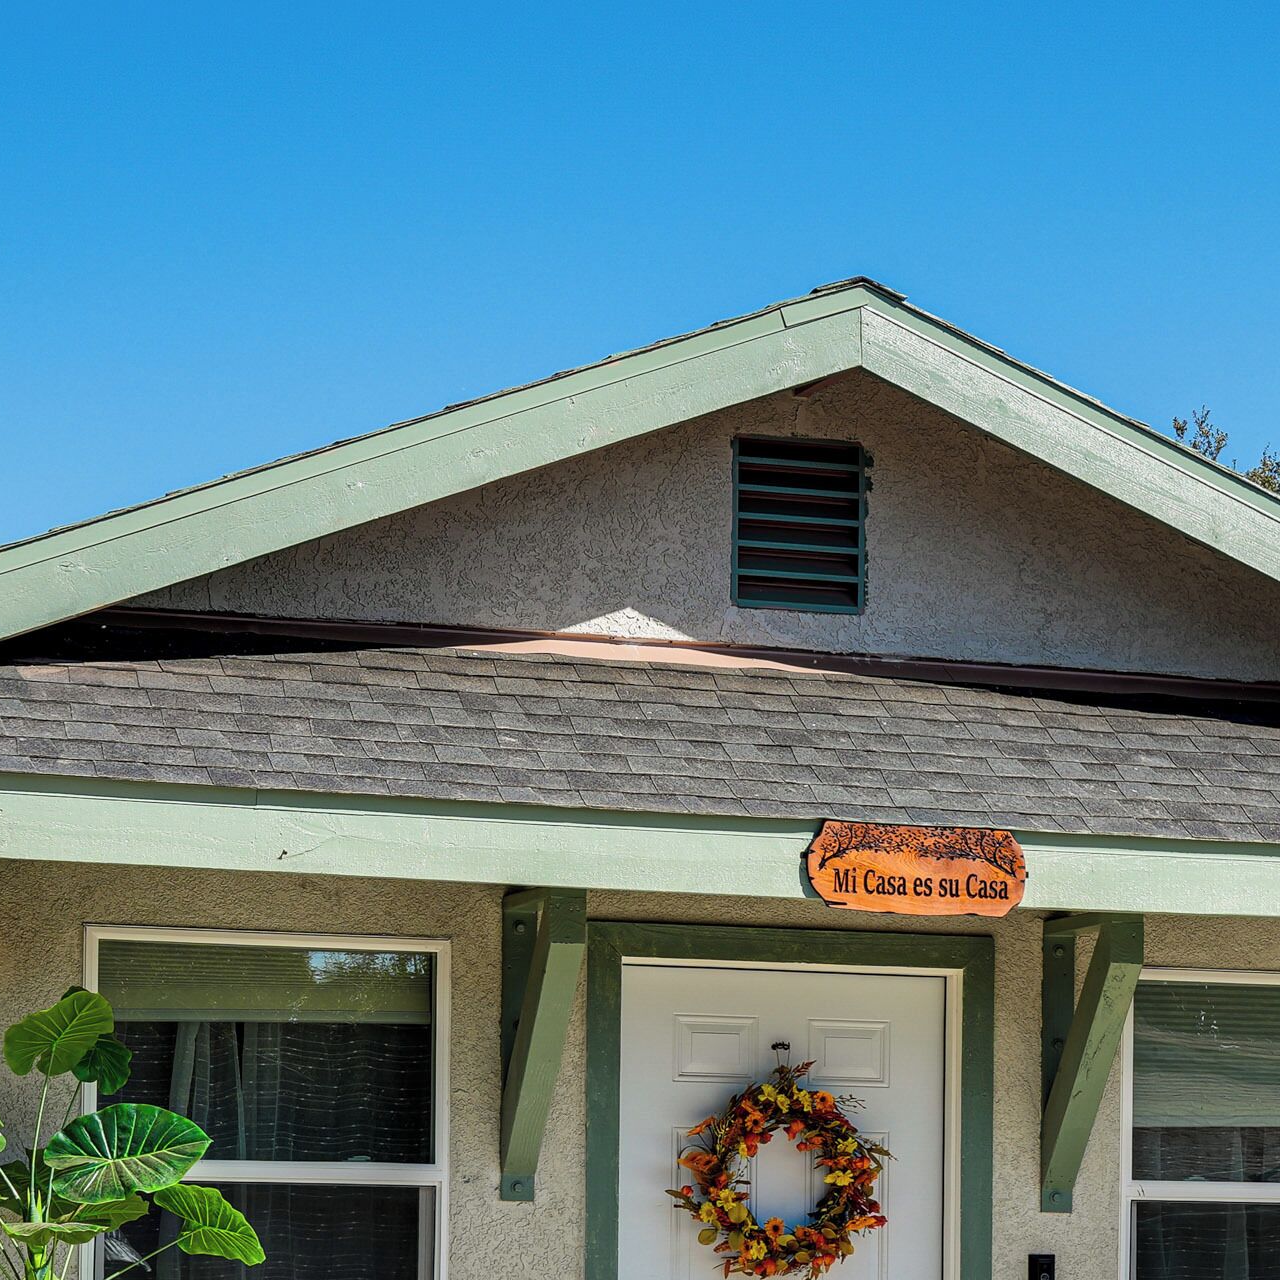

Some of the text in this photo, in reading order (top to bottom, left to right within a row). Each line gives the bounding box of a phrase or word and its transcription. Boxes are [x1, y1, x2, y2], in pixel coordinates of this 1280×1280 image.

[832, 868, 1009, 900] Mi Casa es su Casa
